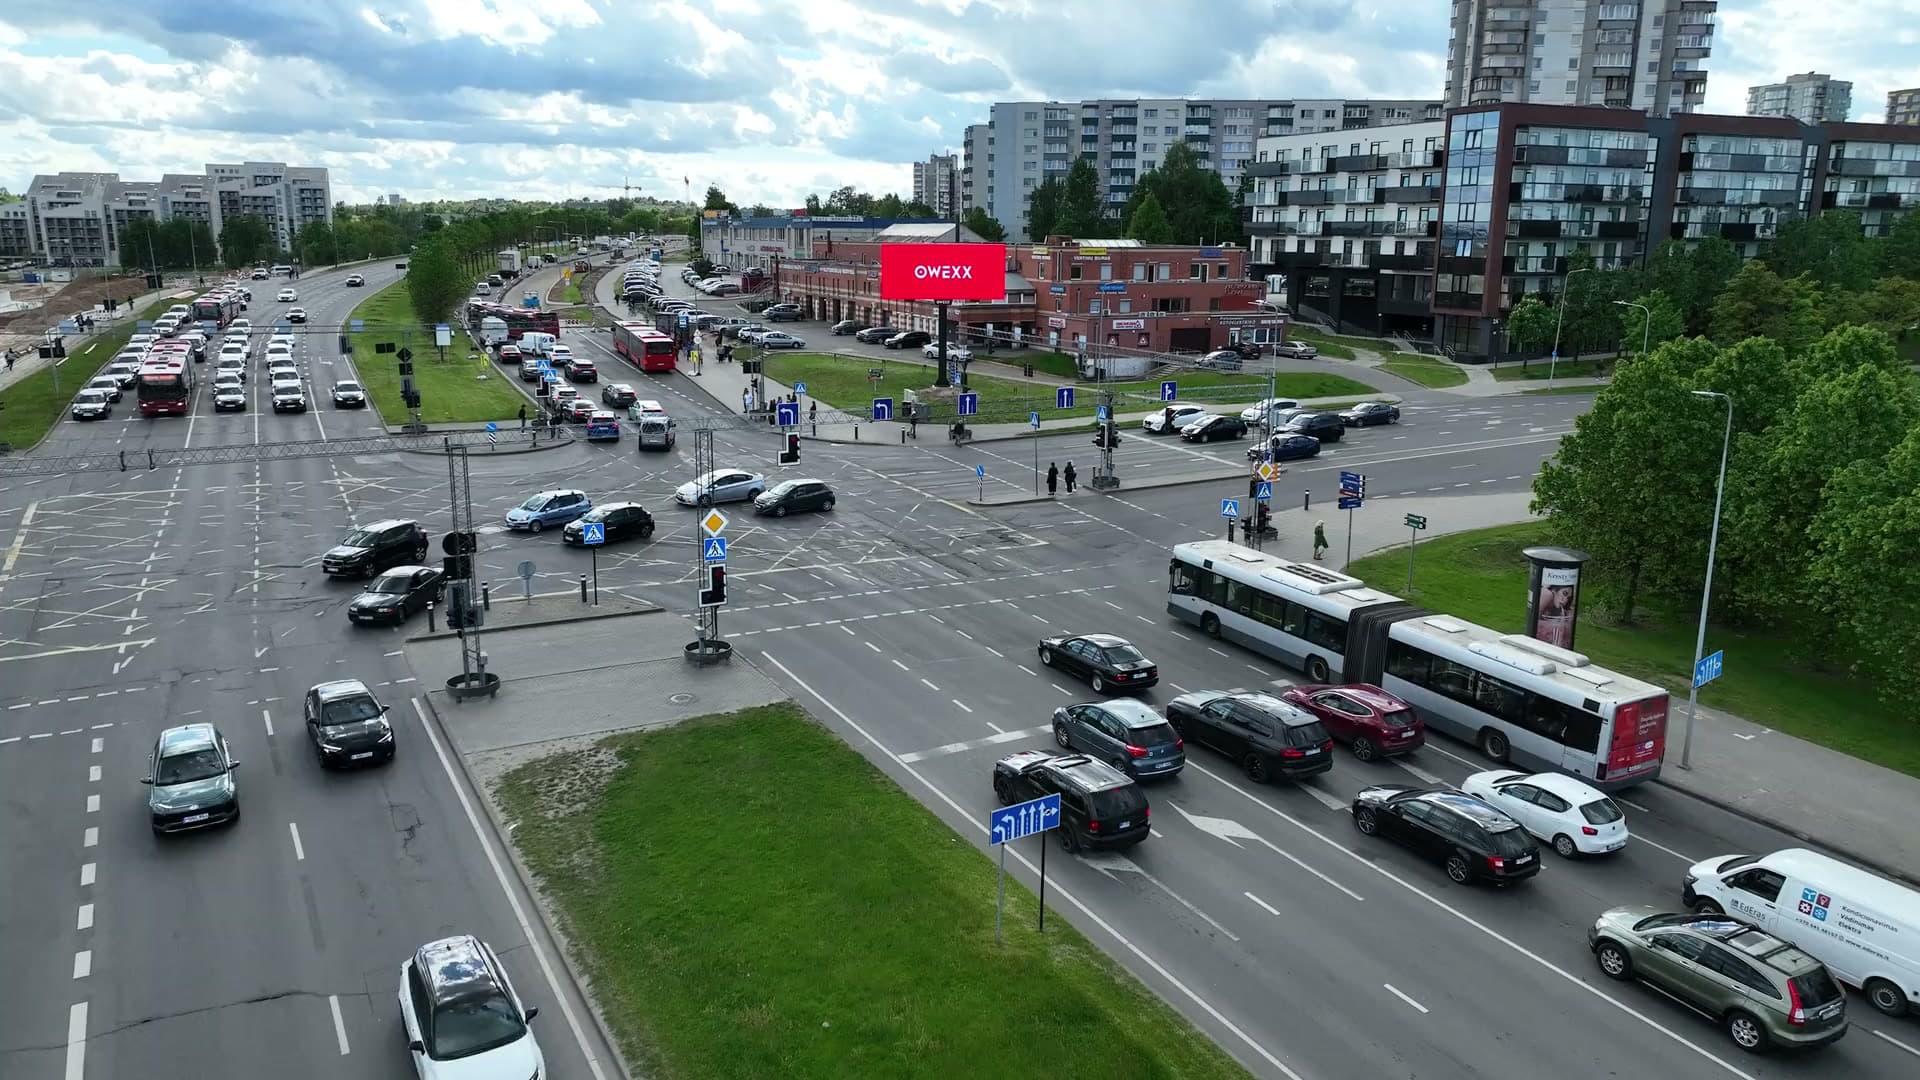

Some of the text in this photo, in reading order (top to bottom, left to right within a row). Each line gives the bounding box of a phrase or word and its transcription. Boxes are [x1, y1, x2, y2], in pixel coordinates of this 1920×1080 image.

[914, 265, 972, 279] OWEXX
[1739, 902, 1766, 920] EdEras
[1841, 905, 1898, 933] Kondicionavimas
[1838, 921, 1862, 935] Elektra
